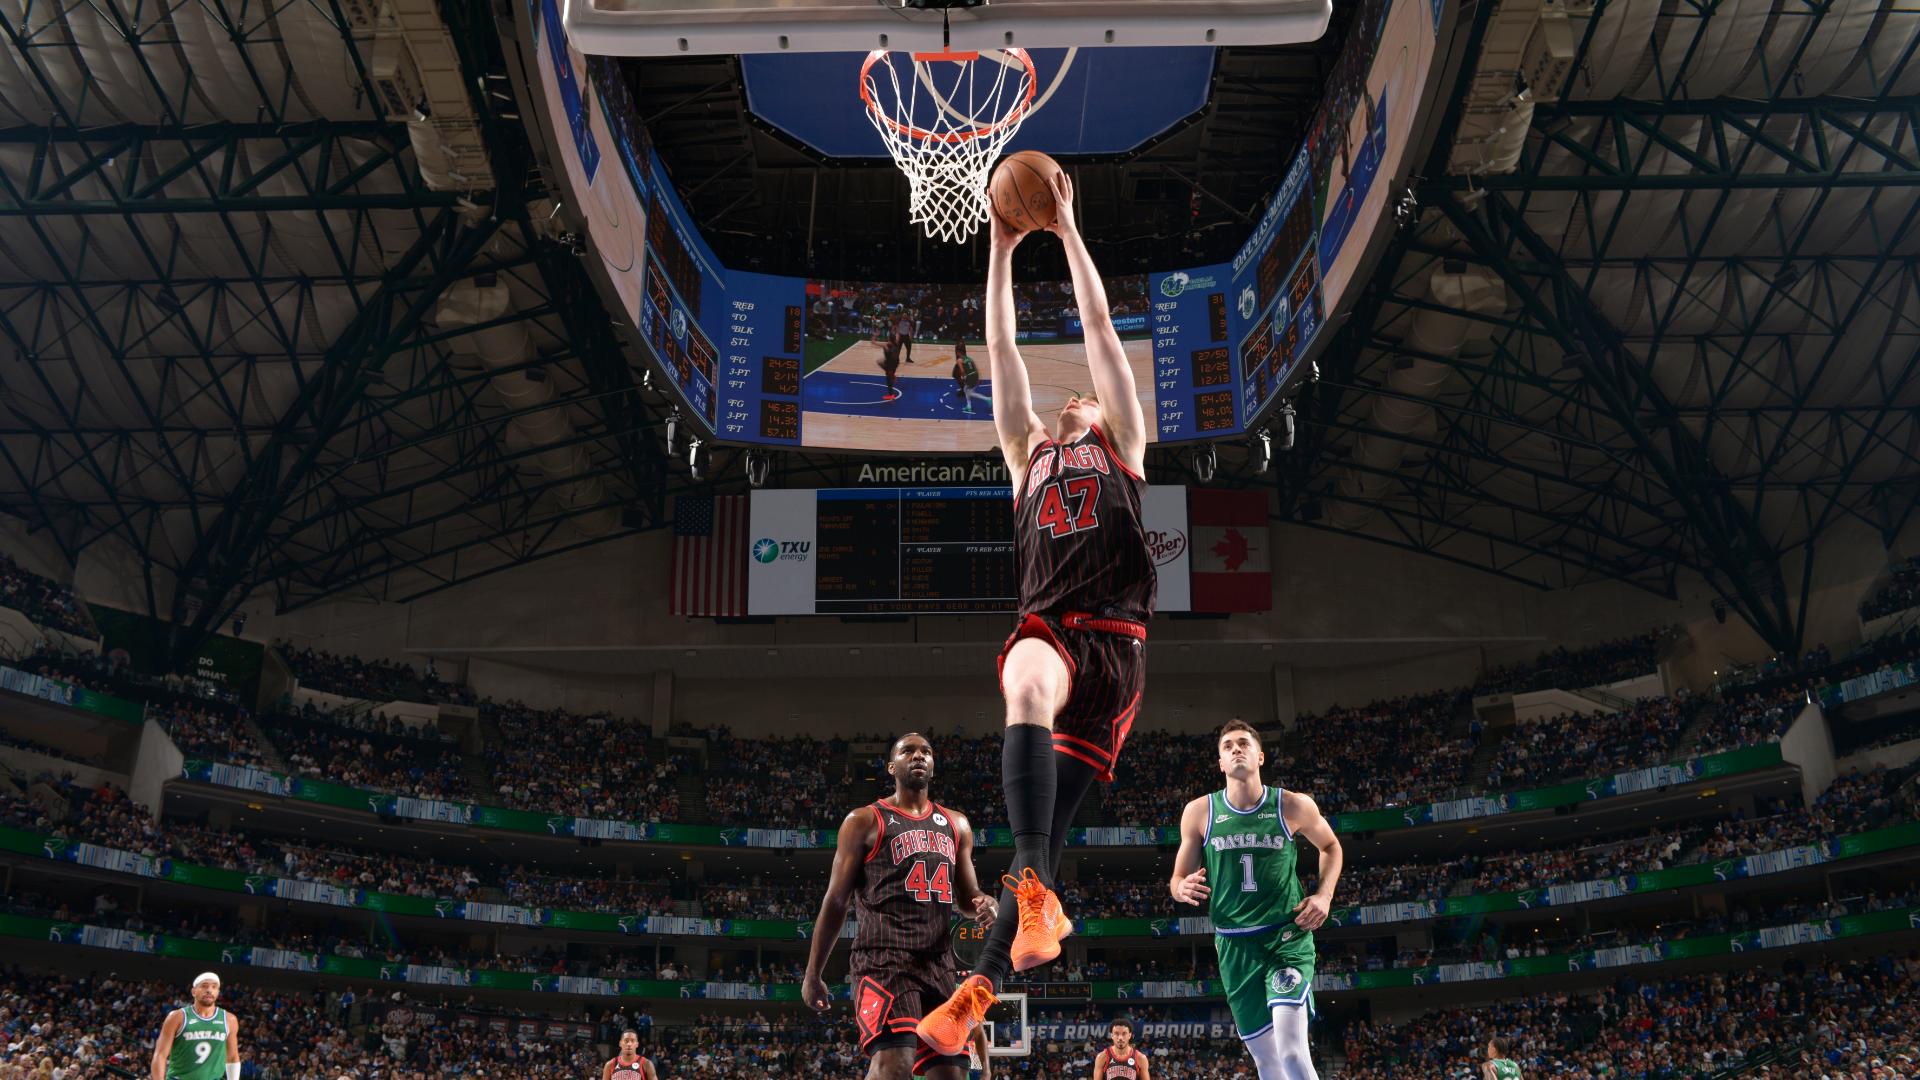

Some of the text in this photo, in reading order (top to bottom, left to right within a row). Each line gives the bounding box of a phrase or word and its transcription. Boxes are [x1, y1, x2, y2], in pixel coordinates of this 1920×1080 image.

[732, 301, 755, 311] REB
[1155, 302, 1177, 312] REB
[732, 313, 748, 322] TO
[1155, 315, 1171, 323] TO
[731, 325, 755, 335] BLK
[1157, 325, 1179, 334] BLK
[730, 338, 751, 347] STL
[1157, 338, 1177, 348] STL
[729, 356, 747, 364] FG
[1158, 356, 1175, 365] FG
[729, 368, 750, 377] 3-PT
[1159, 368, 1180, 377] 3-PT
[728, 380, 746, 389] FT
[1160, 381, 1176, 389] FT
[728, 399, 744, 408] FG
[1161, 400, 1178, 408] FG
[726, 412, 748, 421] 3-PT
[1162, 412, 1183, 420] 3-PT
[726, 424, 744, 433] FT
[1162, 425, 1179, 433] FT
[858, 462, 965, 482] American
[1036, 474, 1101, 539] 47
[780, 541, 811, 553] TXU
[780, 553, 809, 562] energy
[198, 656, 214, 666] DO
[197, 668, 228, 681] WHAT
[1257, 812, 1277, 820] chime
[1211, 833, 1284, 852] DALLAS
[891, 830, 956, 865] CHICAGO
[1239, 854, 1258, 892] 1
[905, 861, 953, 903] 44
[183, 1031, 226, 1041] DALLAS
[1142, 1024, 1206, 1039] PROUD
[1211, 1024, 1223, 1037] &
[195, 1041, 212, 1064] 9
